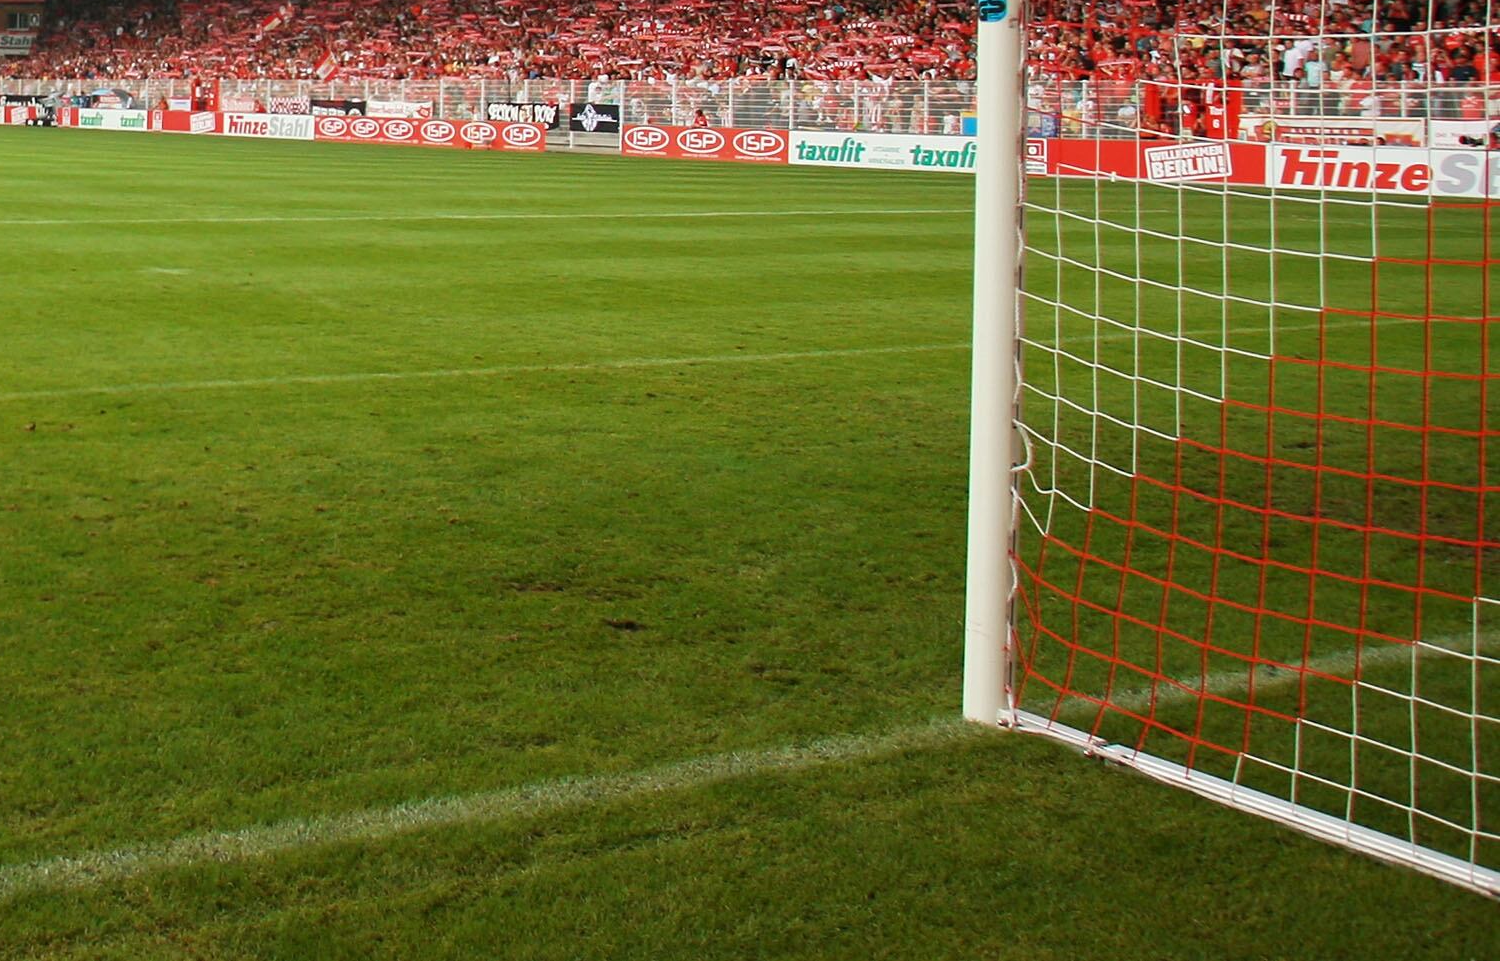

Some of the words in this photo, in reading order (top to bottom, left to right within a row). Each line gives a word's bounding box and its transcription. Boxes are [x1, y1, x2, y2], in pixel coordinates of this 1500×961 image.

[427, 125, 449, 138] ISP
[467, 126, 490, 140] ISP
[510, 128, 534, 141] ISP
[633, 131, 662, 145] ISP
[686, 133, 717, 149] ISP
[743, 135, 776, 151] ISP
[796, 137, 866, 163] taxofit
[910, 141, 977, 168] taxofi
[1150, 145, 1223, 162] WILLKOMMEN
[1152, 158, 1225, 178] BERLIN!
